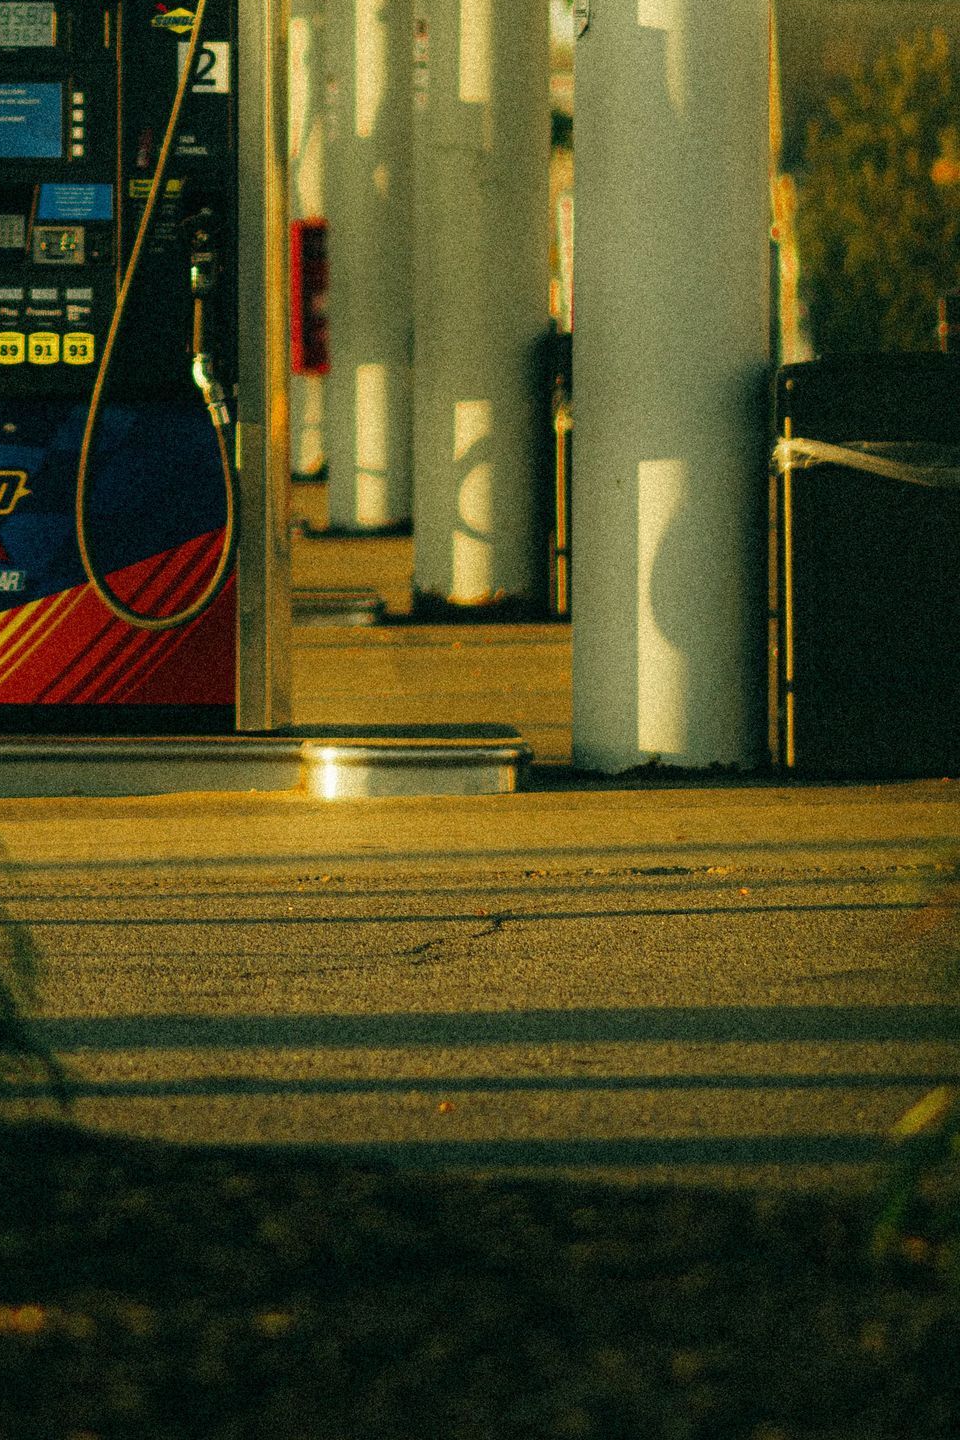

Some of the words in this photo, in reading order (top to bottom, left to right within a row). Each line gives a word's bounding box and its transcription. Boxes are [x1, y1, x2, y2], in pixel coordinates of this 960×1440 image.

[0, 344, 19, 357] 89
[34, 344, 52, 357] 91
[69, 344, 88, 357] 93
